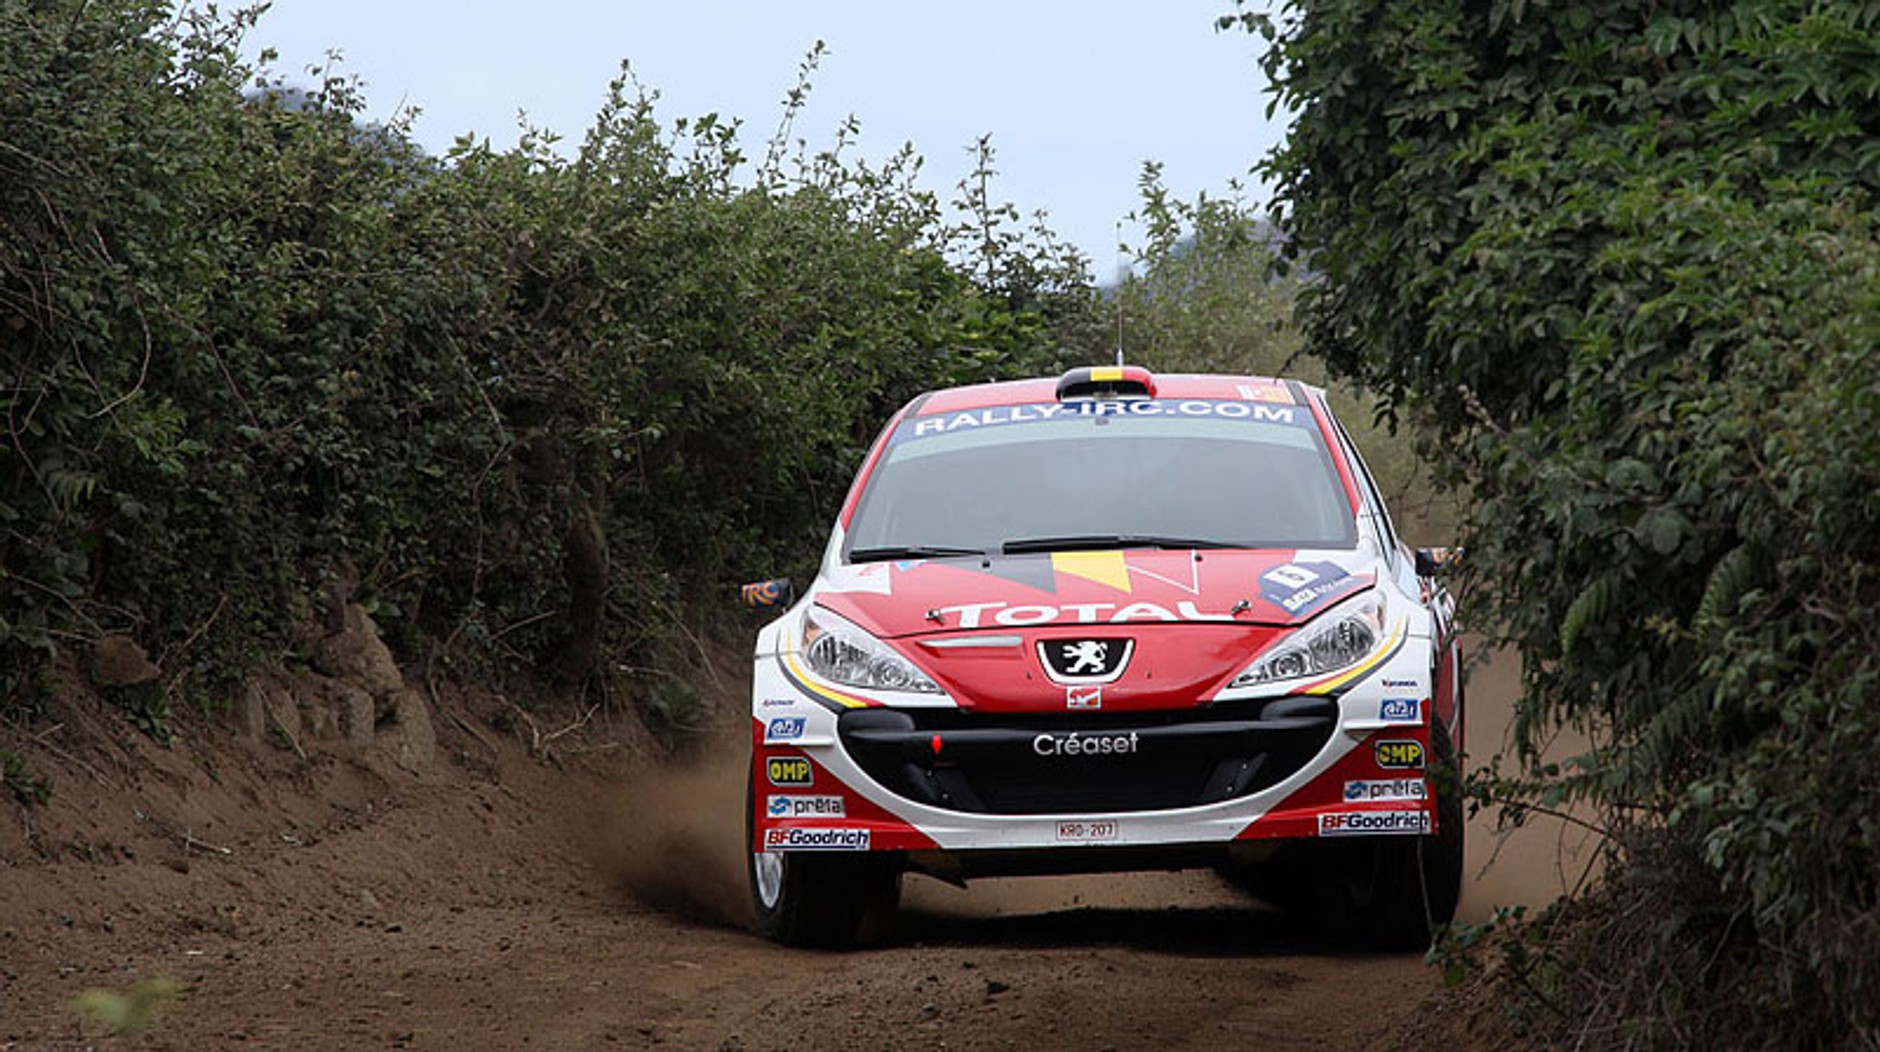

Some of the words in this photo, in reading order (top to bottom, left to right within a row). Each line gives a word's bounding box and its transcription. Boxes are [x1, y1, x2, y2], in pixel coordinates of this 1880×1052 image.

[915, 400, 1295, 436] RALLY-IRC.COM
[940, 601, 1237, 628] TOTAL
[1033, 731, 1139, 756] Créaset
[1379, 744, 1421, 764] OMP
[770, 761, 808, 781] OMP
[1322, 812, 1428, 829] BFGoodrich
[768, 828, 868, 845] BFGoodrich
